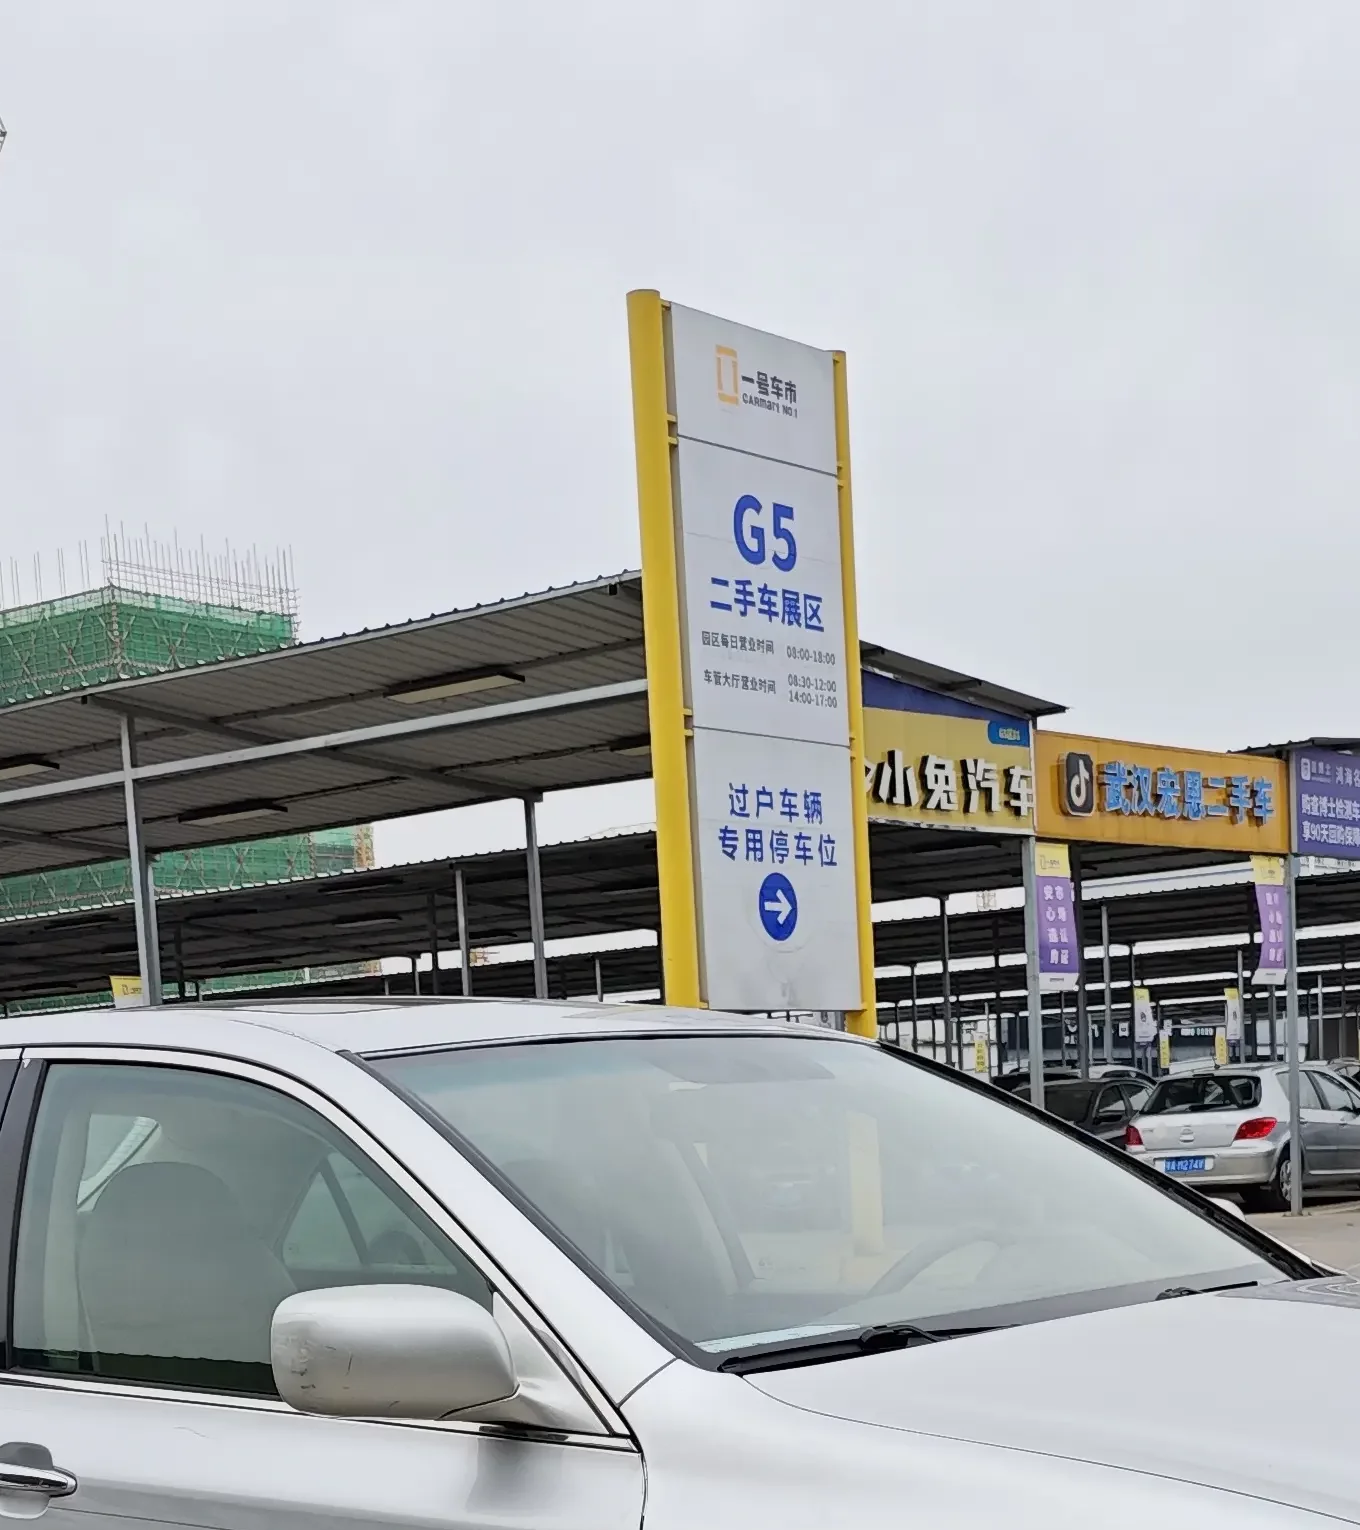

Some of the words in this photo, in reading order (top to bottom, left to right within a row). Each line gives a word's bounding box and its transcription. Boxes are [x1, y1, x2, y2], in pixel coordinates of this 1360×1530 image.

[741, 370, 797, 404] 一号车市
[732, 493, 798, 572] G5
[709, 577, 825, 633] 二手车展区
[701, 630, 775, 655] 园区每日营业时间
[786, 645, 836, 665] 08:00-18:00
[703, 669, 777, 694] 车管大厅营业时间
[787, 673, 837, 692] 08:30-12:00
[788, 690, 838, 708] 14:00-17:00
[728, 782, 824, 825] 过户车辆
[717, 825, 838, 868] 专用停车位
